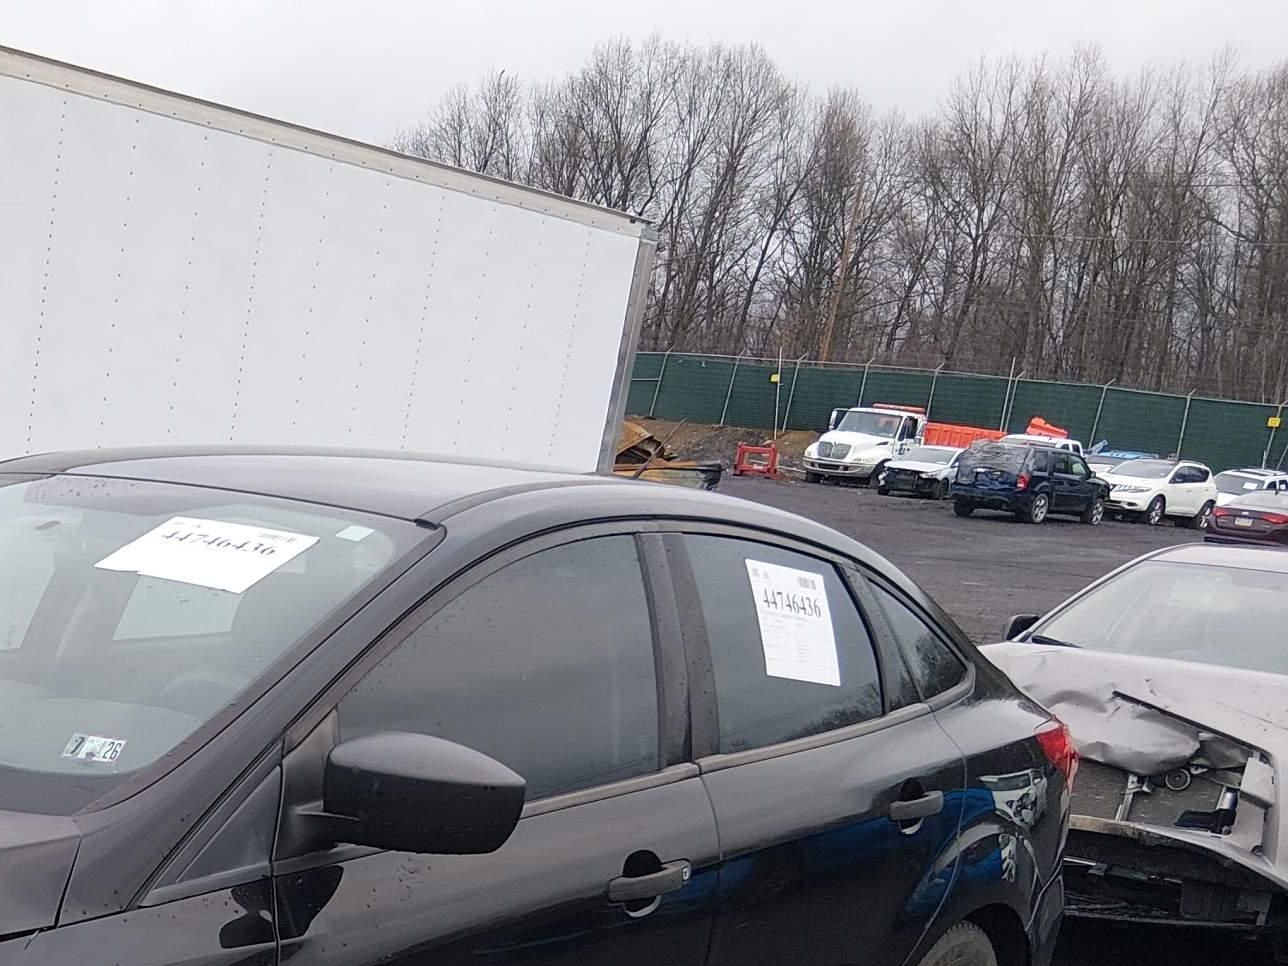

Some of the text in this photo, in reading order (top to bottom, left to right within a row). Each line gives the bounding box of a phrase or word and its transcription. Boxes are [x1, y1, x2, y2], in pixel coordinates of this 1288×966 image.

[763, 588, 821, 618] 44746436
[71, 736, 122, 760] 7 26
